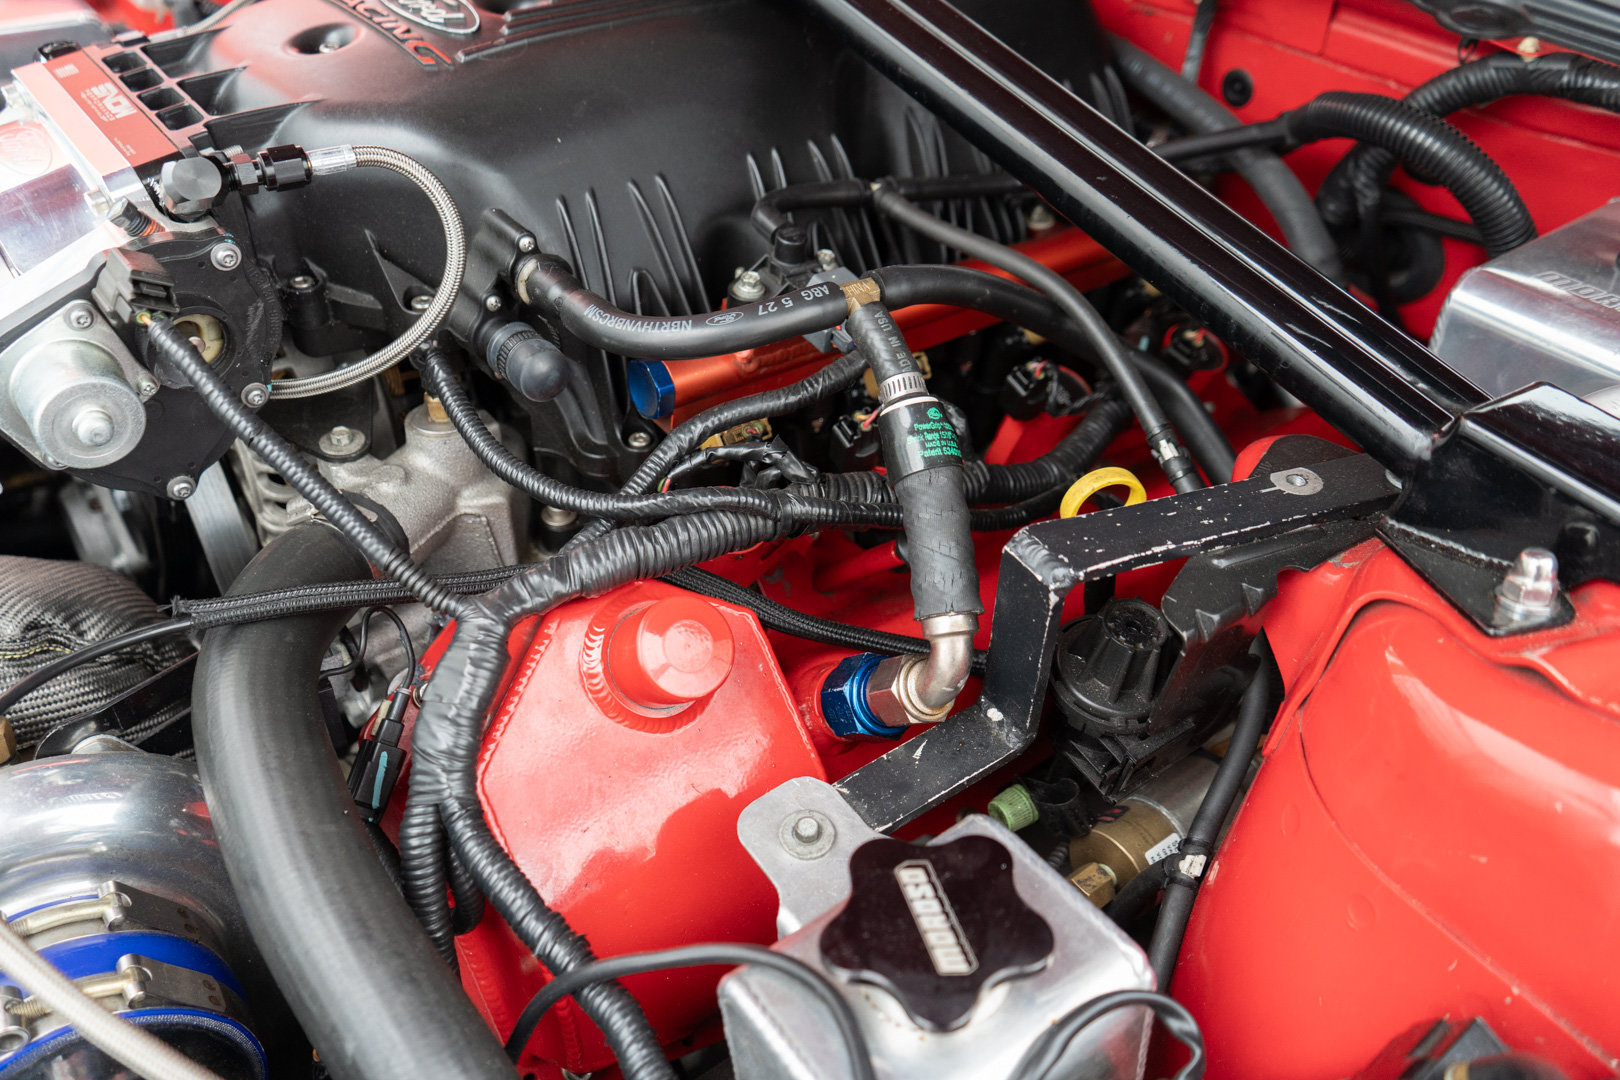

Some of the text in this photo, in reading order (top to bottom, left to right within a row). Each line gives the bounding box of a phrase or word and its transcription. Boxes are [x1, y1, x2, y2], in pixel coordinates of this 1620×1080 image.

[800, 284, 830, 301] ABG
[758, 301, 778, 316] 27
[781, 297, 794, 308] 5
[709, 312, 740, 325] Ford
[874, 310, 893, 332] USA
[896, 352, 912, 373] ADE
[899, 866, 973, 974] MOROSO
